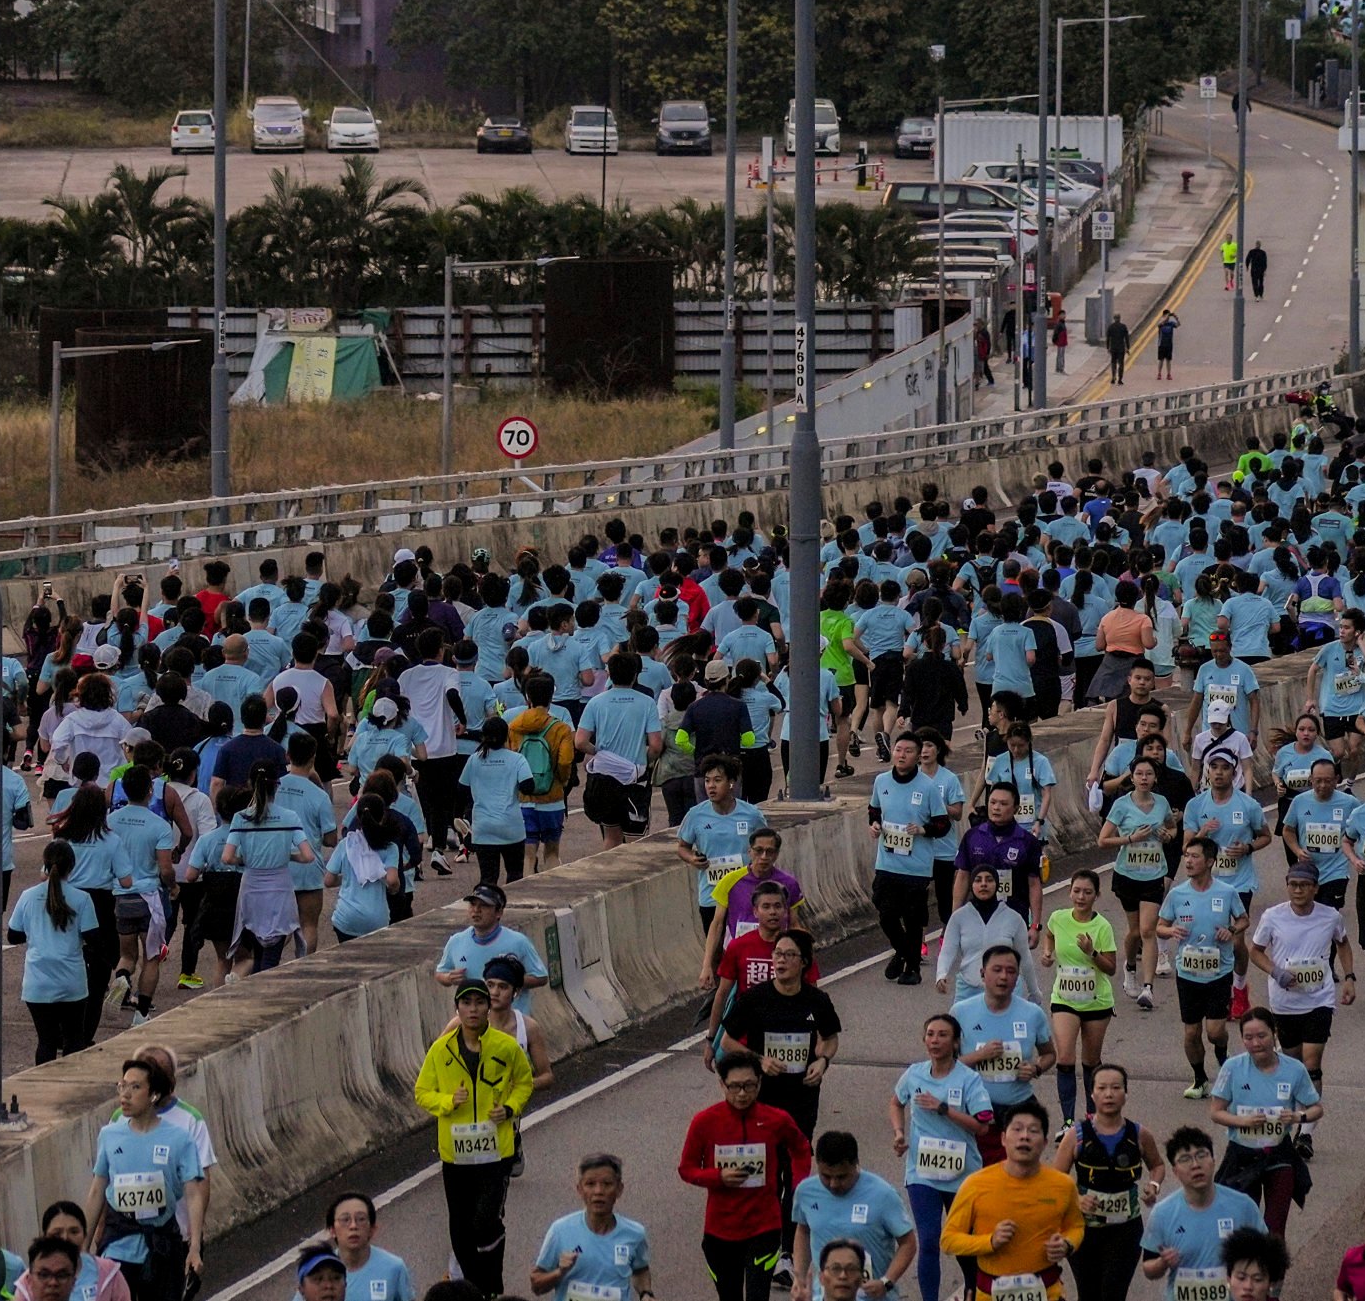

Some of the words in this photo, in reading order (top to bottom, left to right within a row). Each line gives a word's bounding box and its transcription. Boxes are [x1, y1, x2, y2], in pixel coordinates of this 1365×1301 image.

[796, 326, 805, 387] 47690
[796, 393, 804, 404] A
[504, 430, 530, 446] 70
[1017, 804, 1034, 815] 255
[1307, 833, 1338, 845] K0006
[1128, 852, 1160, 863] M1740
[1215, 857, 1236, 868] 1208
[1183, 956, 1219, 969] M3168
[746, 961, 777, 984] 超
[1297, 970, 1324, 984] 0009
[1059, 979, 1095, 991] M0010
[767, 1048, 808, 1061] M3889
[977, 1057, 1020, 1072] M1352
[454, 1136, 497, 1154] M3421
[919, 1153, 963, 1171] M4210
[118, 1189, 163, 1207] K3740
[1098, 1198, 1128, 1212] 4292
[1177, 1285, 1226, 1301] M1989
